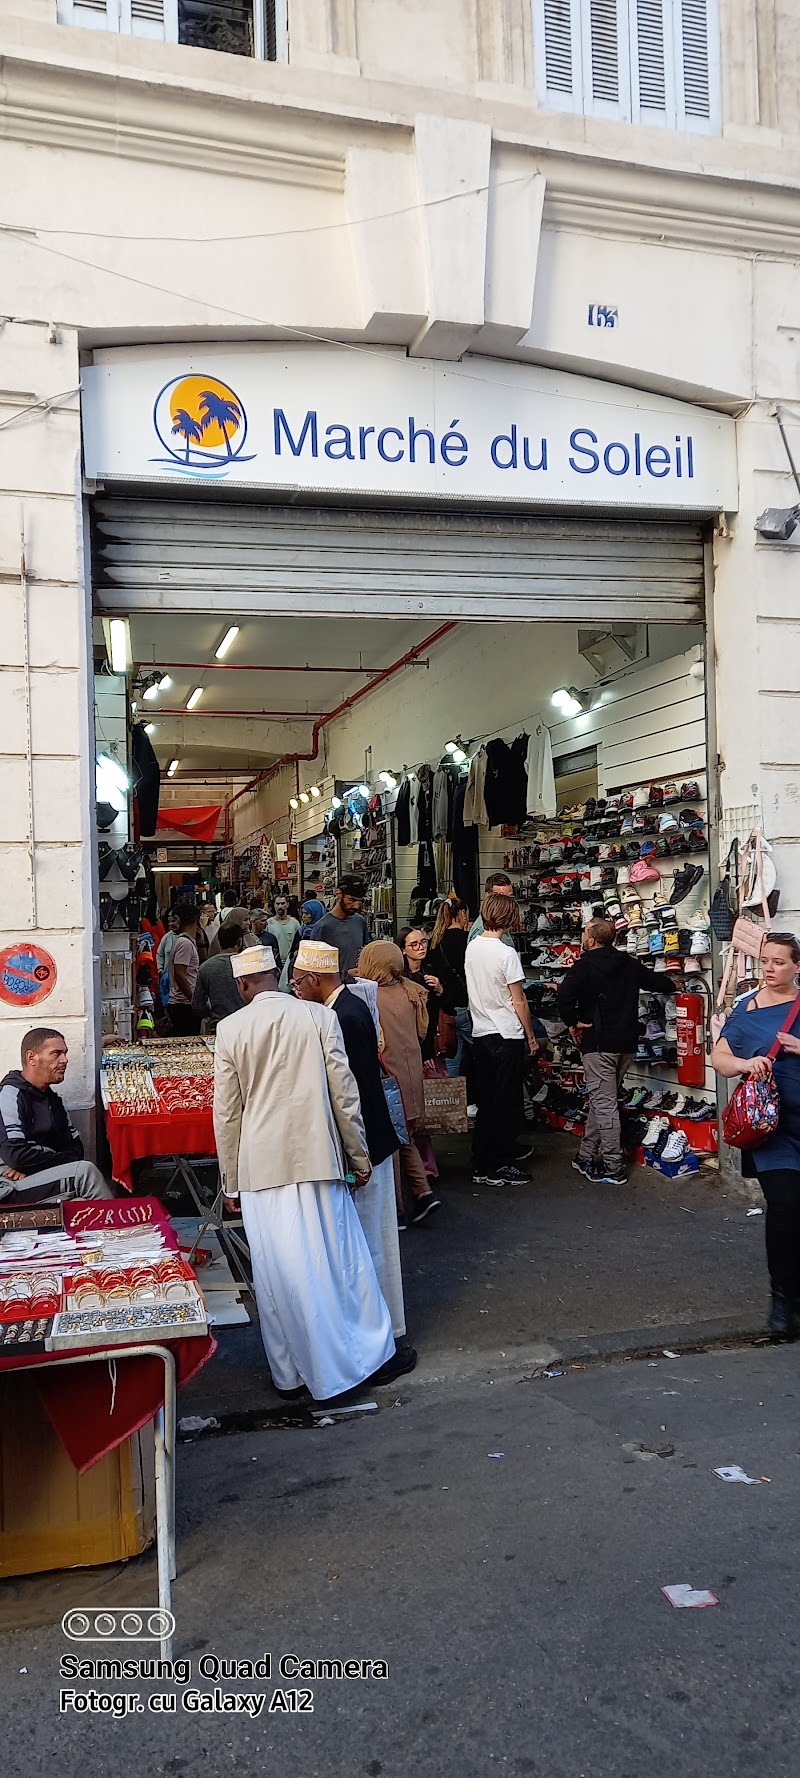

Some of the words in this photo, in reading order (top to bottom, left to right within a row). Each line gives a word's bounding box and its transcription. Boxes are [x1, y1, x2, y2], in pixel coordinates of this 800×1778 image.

[273, 409, 469, 467] Marché
[490, 424, 548, 471] du
[568, 428, 695, 478] Soleil
